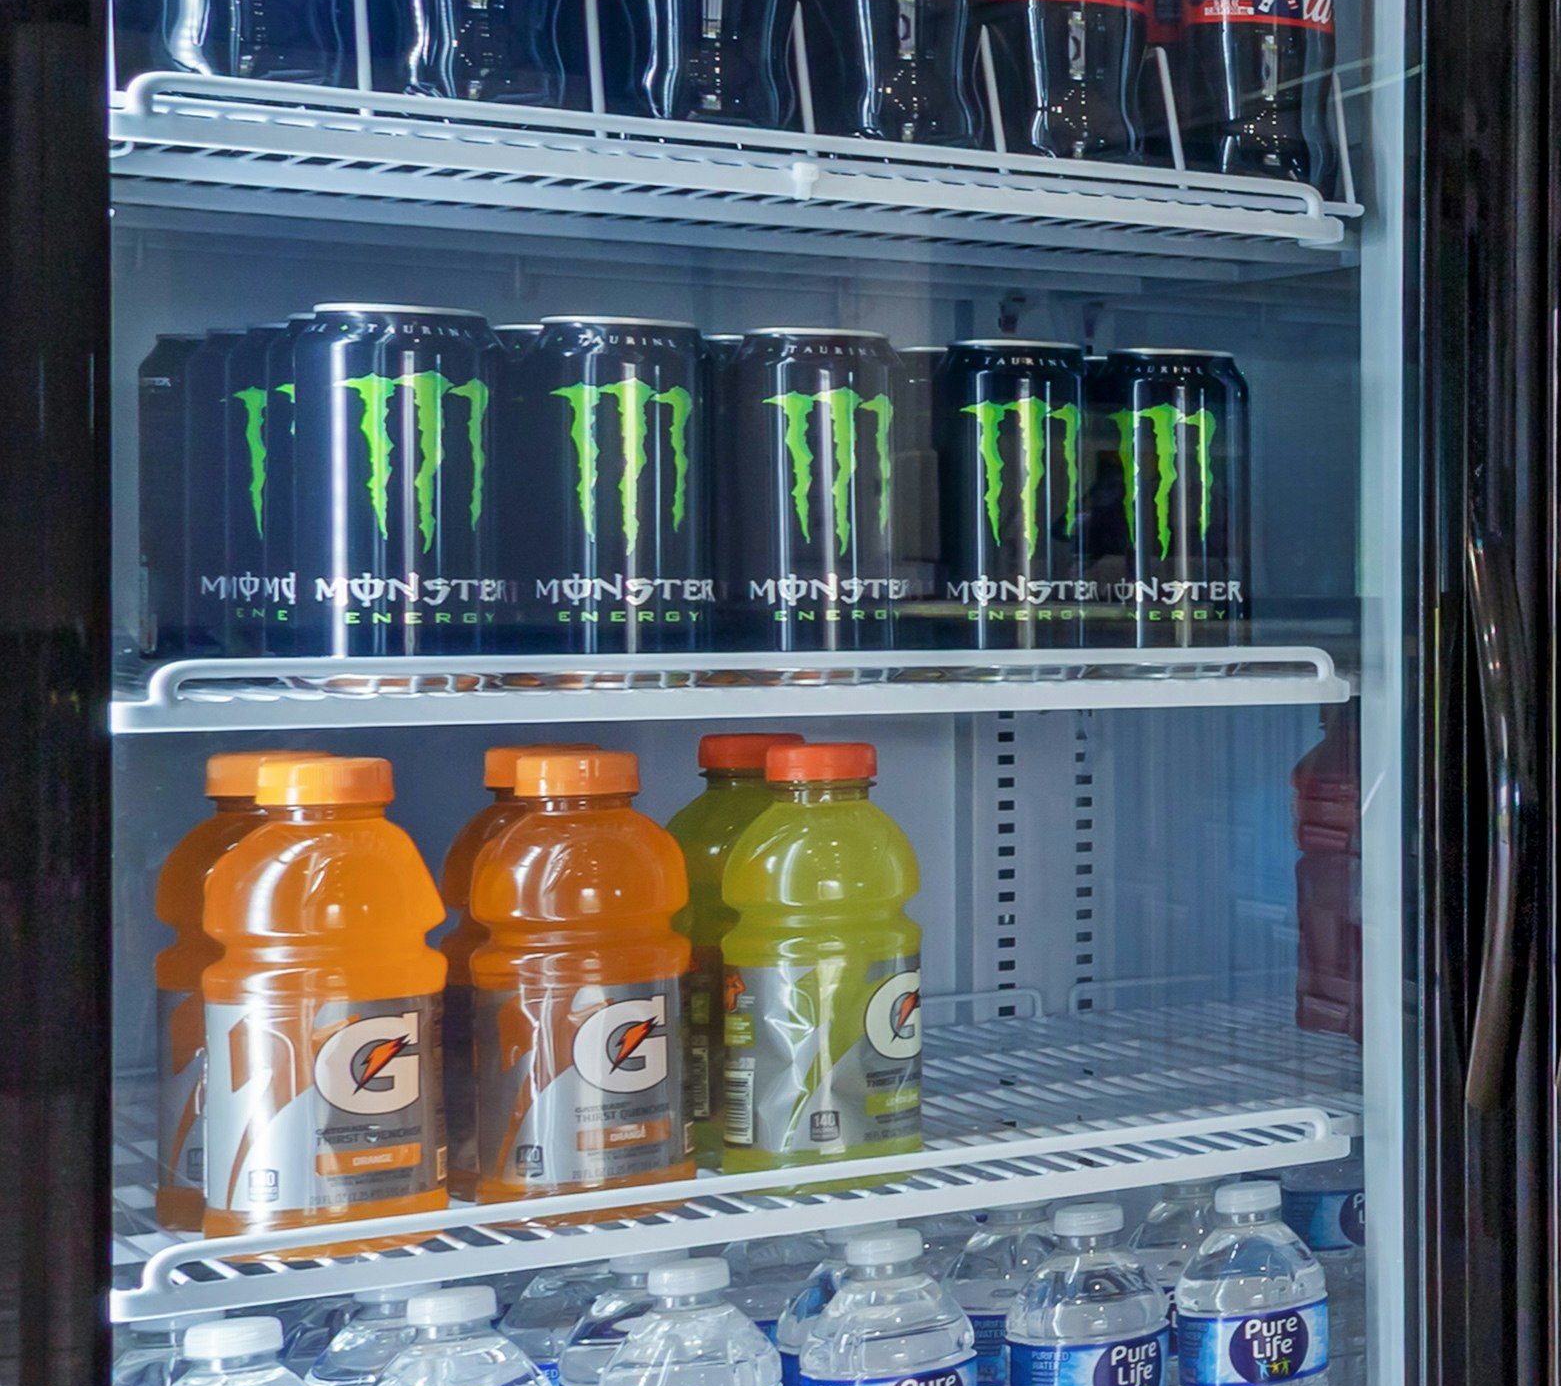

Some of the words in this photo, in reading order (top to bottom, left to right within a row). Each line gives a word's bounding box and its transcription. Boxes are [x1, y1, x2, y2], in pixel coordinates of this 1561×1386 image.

[535, 570, 716, 605] MONSTER
[344, 610, 496, 625] ENERGY
[557, 609, 700, 623] ENERGY
[572, 994, 669, 1094] G
[313, 1013, 421, 1115] G
[813, 1116, 837, 1129] 140
[1243, 1314, 1298, 1340] Pure
[1110, 1340, 1158, 1365] Pure
[1252, 1335, 1294, 1361] Life
